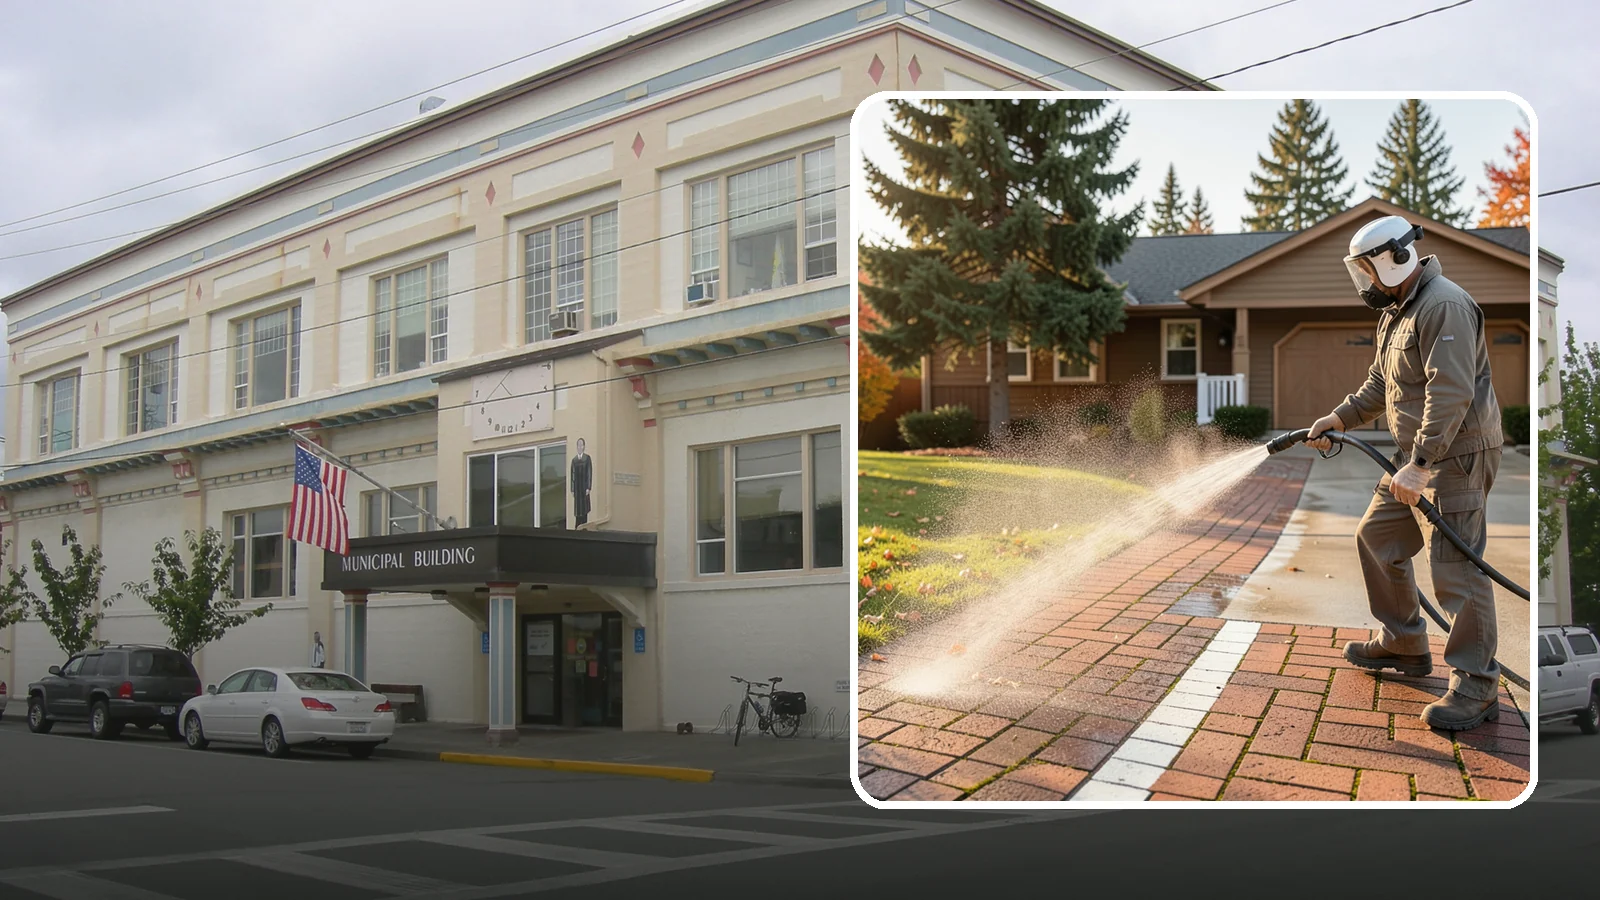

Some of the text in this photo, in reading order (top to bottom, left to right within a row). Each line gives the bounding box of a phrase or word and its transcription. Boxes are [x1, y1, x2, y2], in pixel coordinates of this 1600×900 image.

[494, 424, 500, 432] 10
[521, 420, 525, 428] 2
[529, 414, 533, 422] 3
[342, 546, 475, 572] MUNICIPAL BUILDING
